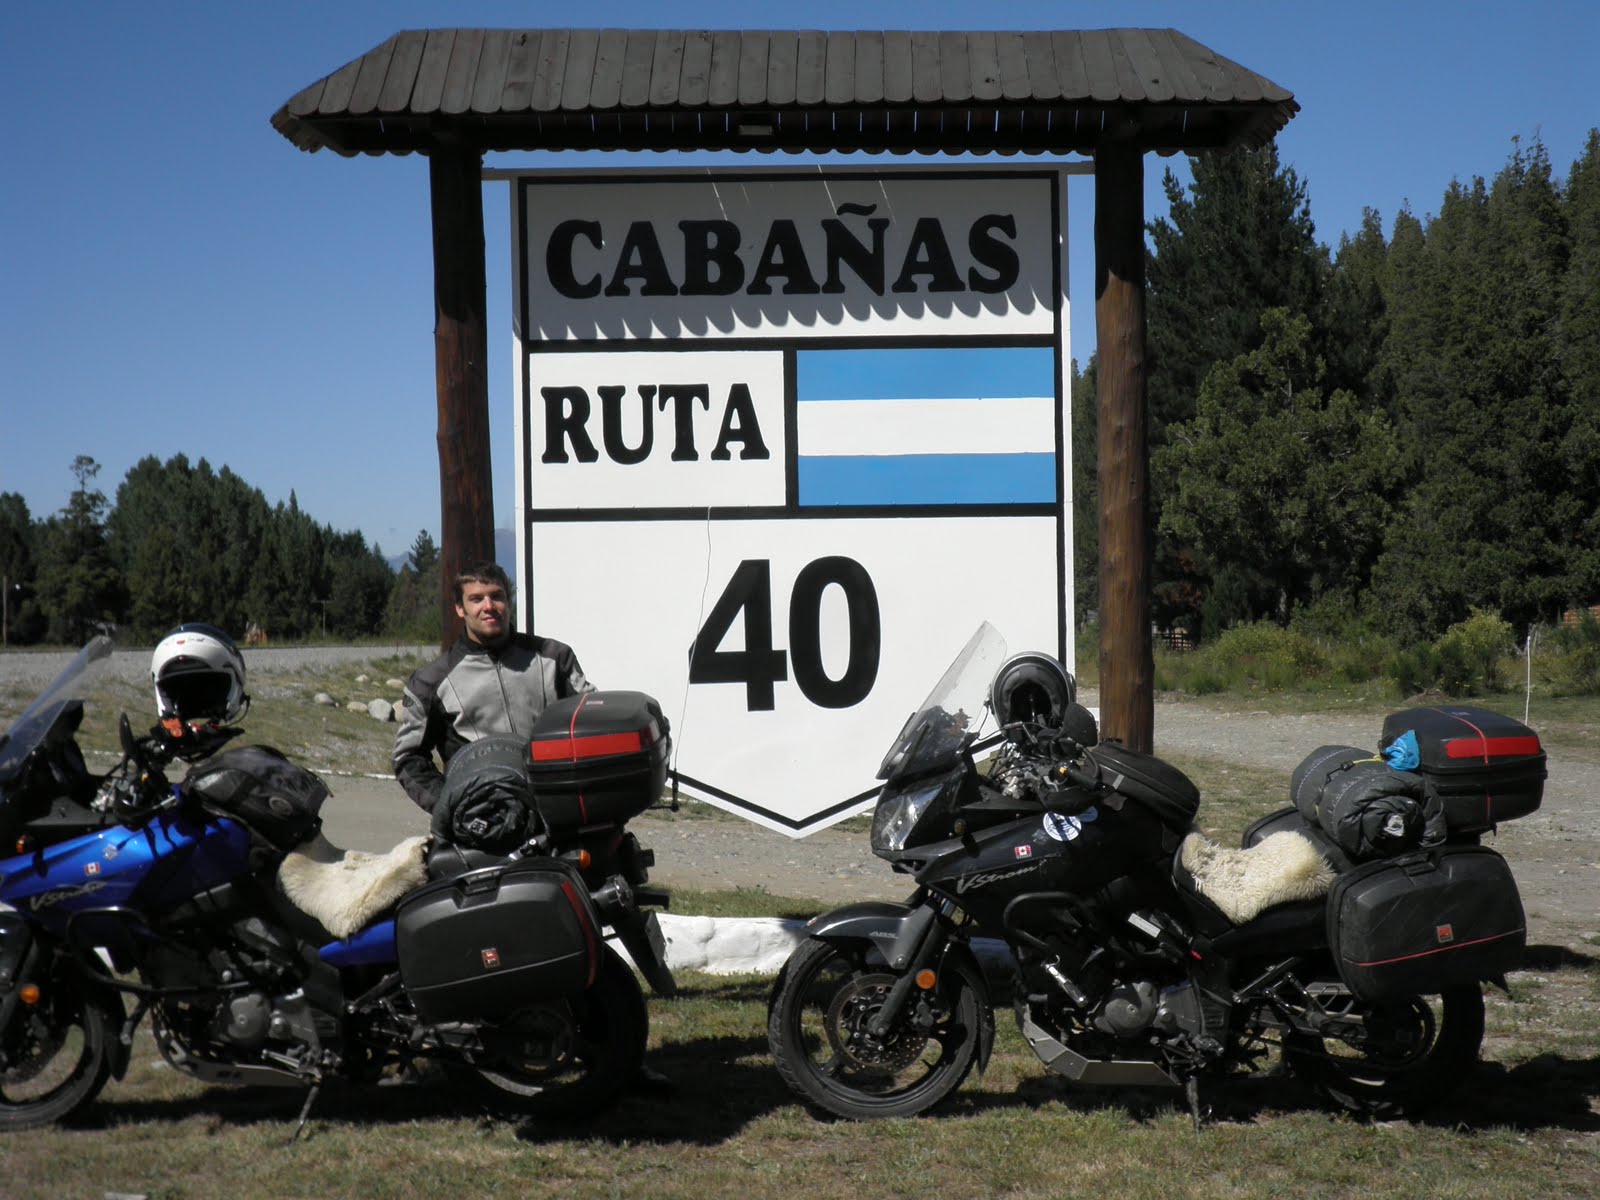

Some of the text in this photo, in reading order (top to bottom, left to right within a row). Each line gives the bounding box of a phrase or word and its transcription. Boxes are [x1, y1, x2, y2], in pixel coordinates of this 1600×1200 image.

[545, 202, 1020, 300] CABAÑAS
[541, 384, 770, 465] RUTA
[689, 556, 881, 712] 40
